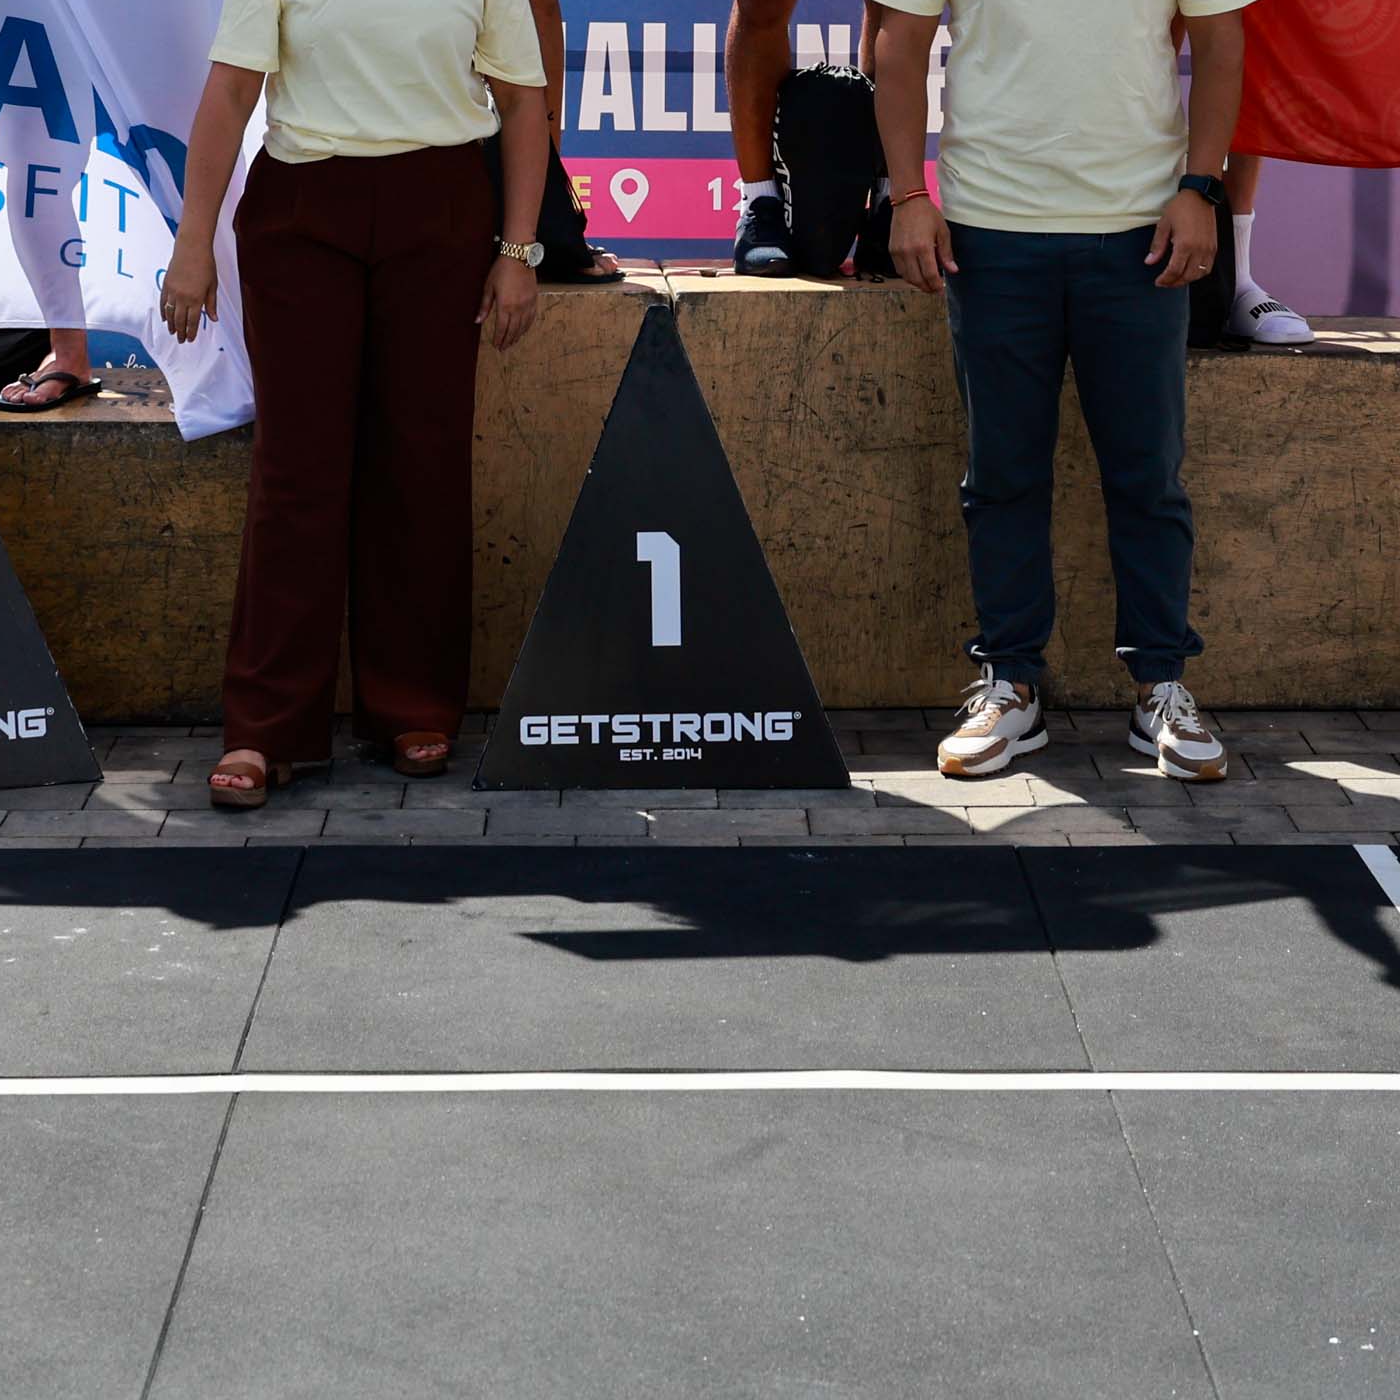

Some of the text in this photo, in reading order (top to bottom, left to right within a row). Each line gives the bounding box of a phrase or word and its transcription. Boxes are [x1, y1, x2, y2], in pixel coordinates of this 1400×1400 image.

[636, 531, 682, 646] 1
[620, 748, 702, 761] EST. 2014
